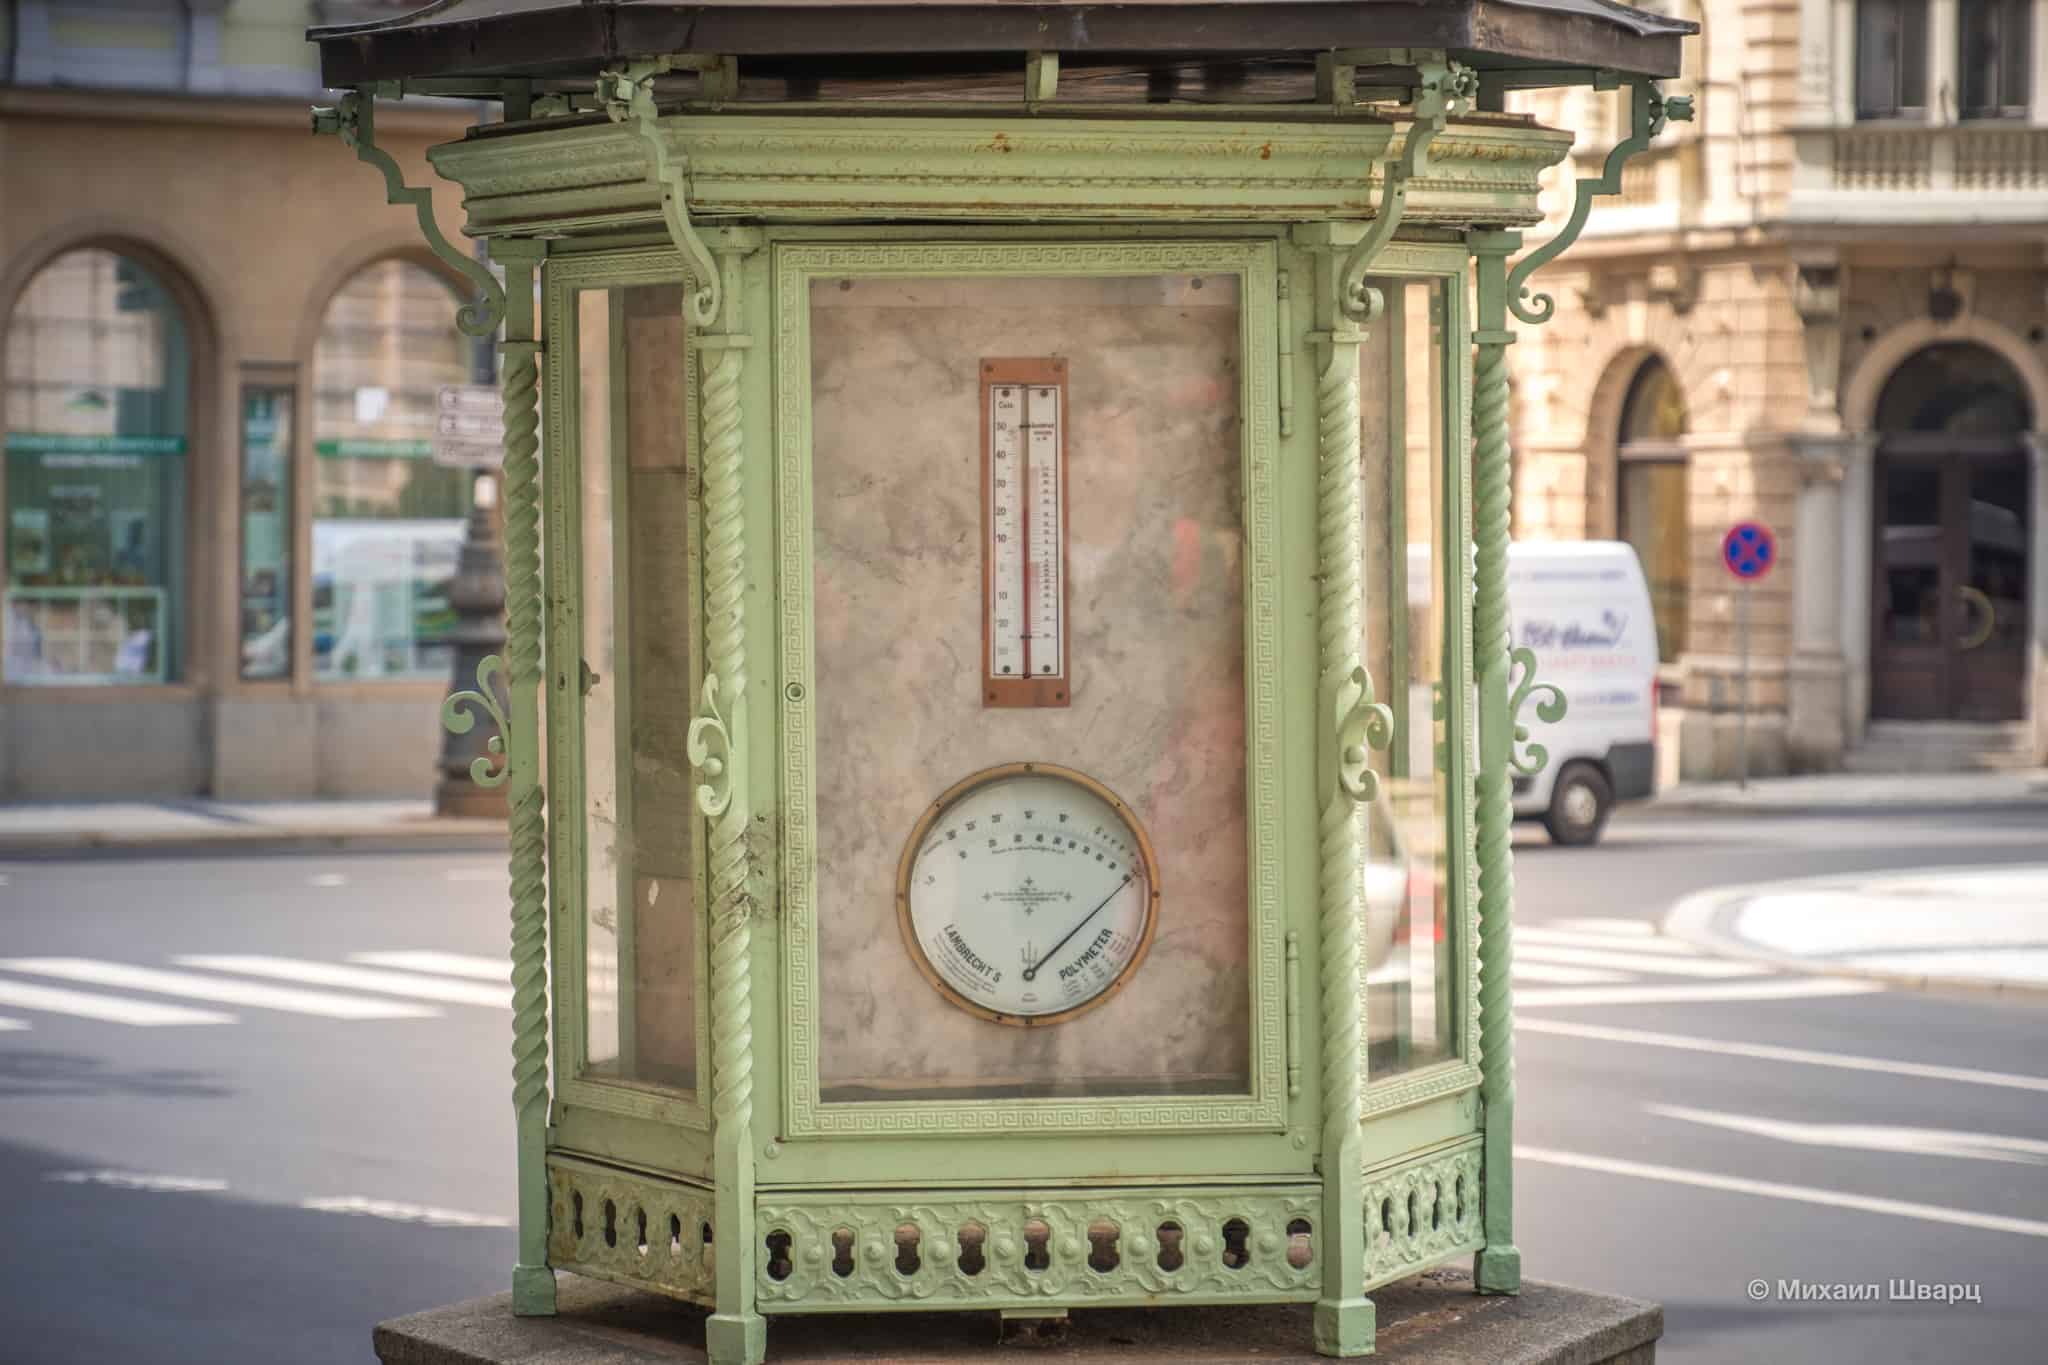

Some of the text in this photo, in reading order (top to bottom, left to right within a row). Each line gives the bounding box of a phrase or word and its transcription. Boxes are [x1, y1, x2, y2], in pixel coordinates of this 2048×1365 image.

[997, 533, 1008, 543] 10
[998, 591, 1008, 601] 10
[944, 923, 1002, 983] LAMBRECHTS
[1059, 928, 1113, 981] POLYMETER
